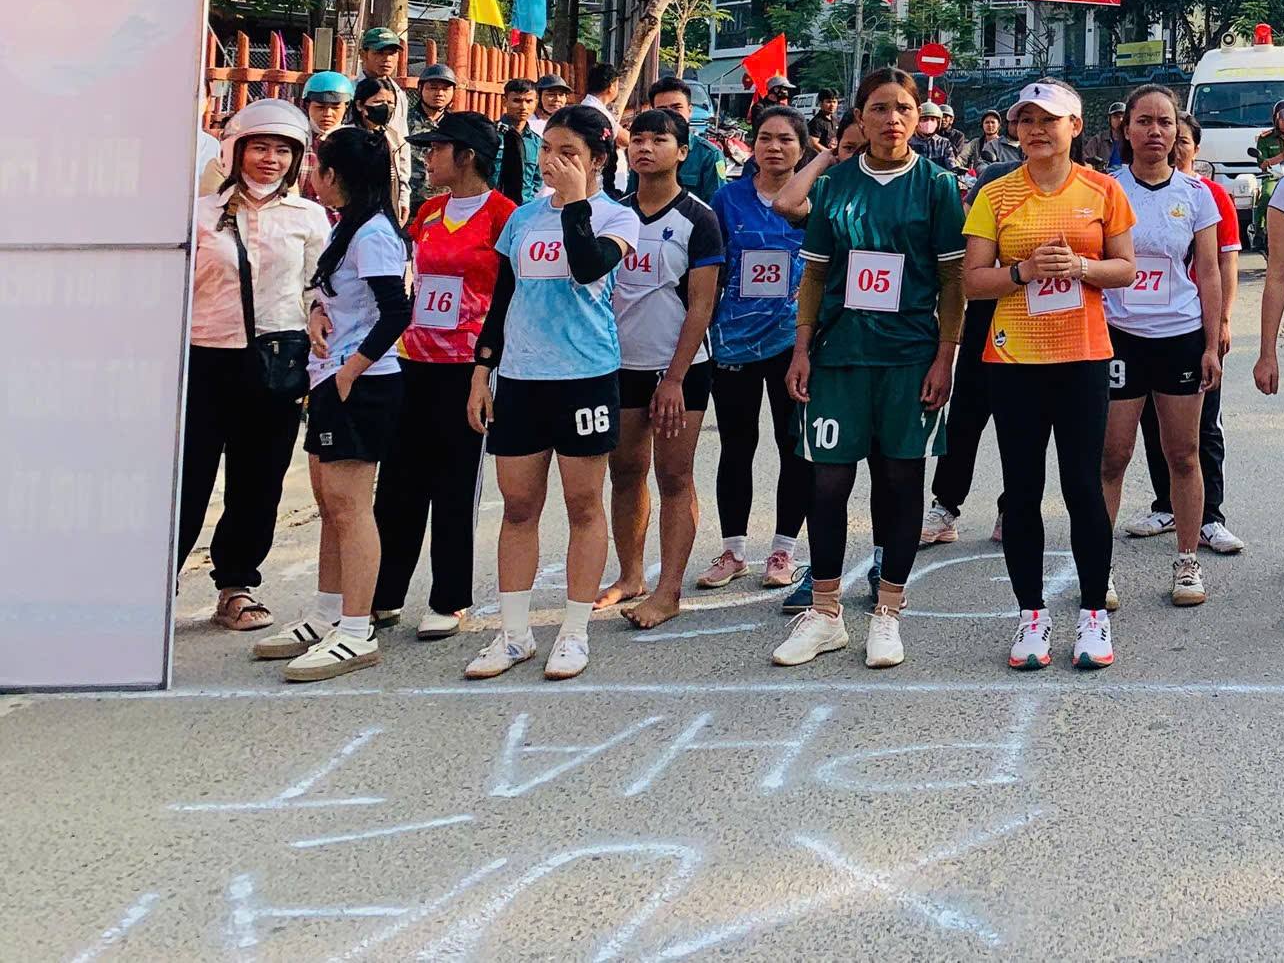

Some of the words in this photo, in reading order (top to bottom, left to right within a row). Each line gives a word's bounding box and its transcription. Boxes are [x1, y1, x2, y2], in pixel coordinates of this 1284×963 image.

[529, 241, 562, 262] 03
[624, 252, 652, 272] 04
[751, 264, 781, 283] 23
[858, 268, 891, 293] 05
[1133, 270, 1163, 291] 27
[1036, 277, 1072, 297] 26
[423, 290, 453, 313] 16
[575, 405, 610, 436] 06
[812, 417, 839, 450] 10
